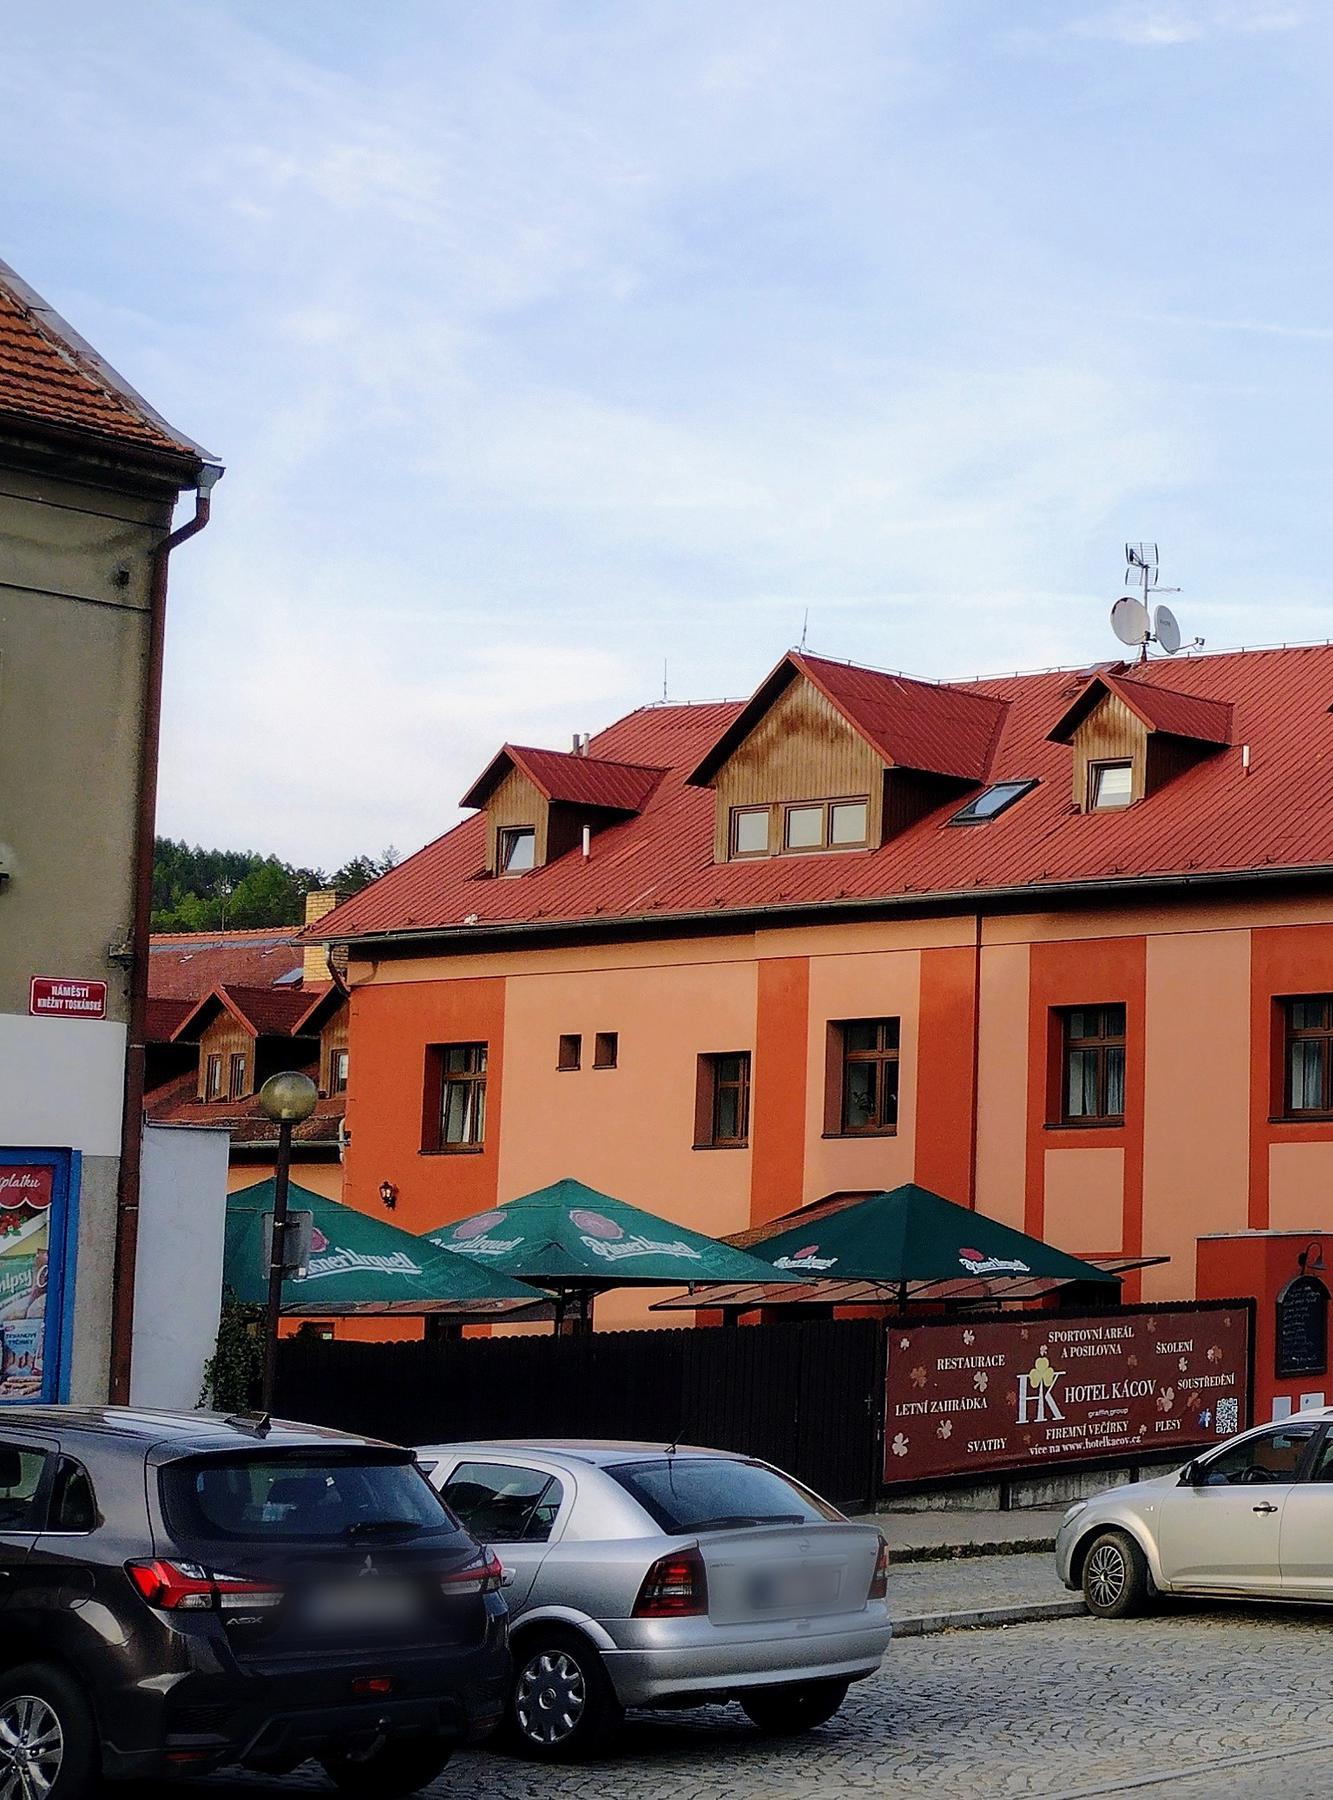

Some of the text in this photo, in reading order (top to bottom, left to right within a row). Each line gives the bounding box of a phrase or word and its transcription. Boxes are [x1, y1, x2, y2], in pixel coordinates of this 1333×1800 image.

[51, 985, 89, 998] NÁMĚSTÍ
[64, 998, 102, 1011] TOSKÁNSKÉ
[1048, 1325, 1135, 1343] SPORTOVNÍ AREÁL
[1061, 1344, 1122, 1359] A POSILOVNA
[1155, 1339, 1193, 1354] ŠKOLENÍ
[937, 1354, 1006, 1371] RESTAURACE
[1177, 1372, 1235, 1390] SOUSTŘEDĚNÍ
[1064, 1379, 1157, 1403] HOTEL KÁCOV
[895, 1397, 988, 1416] LETNÍ ZAHRÁDKA
[1045, 1420, 1129, 1440] FIREMNÍ VEČÍRKY
[1155, 1418, 1182, 1432] PLESY
[967, 1437, 1007, 1453] SVATBY
[1029, 1443, 1048, 1456] více
[1049, 1443, 1061, 1453] na
